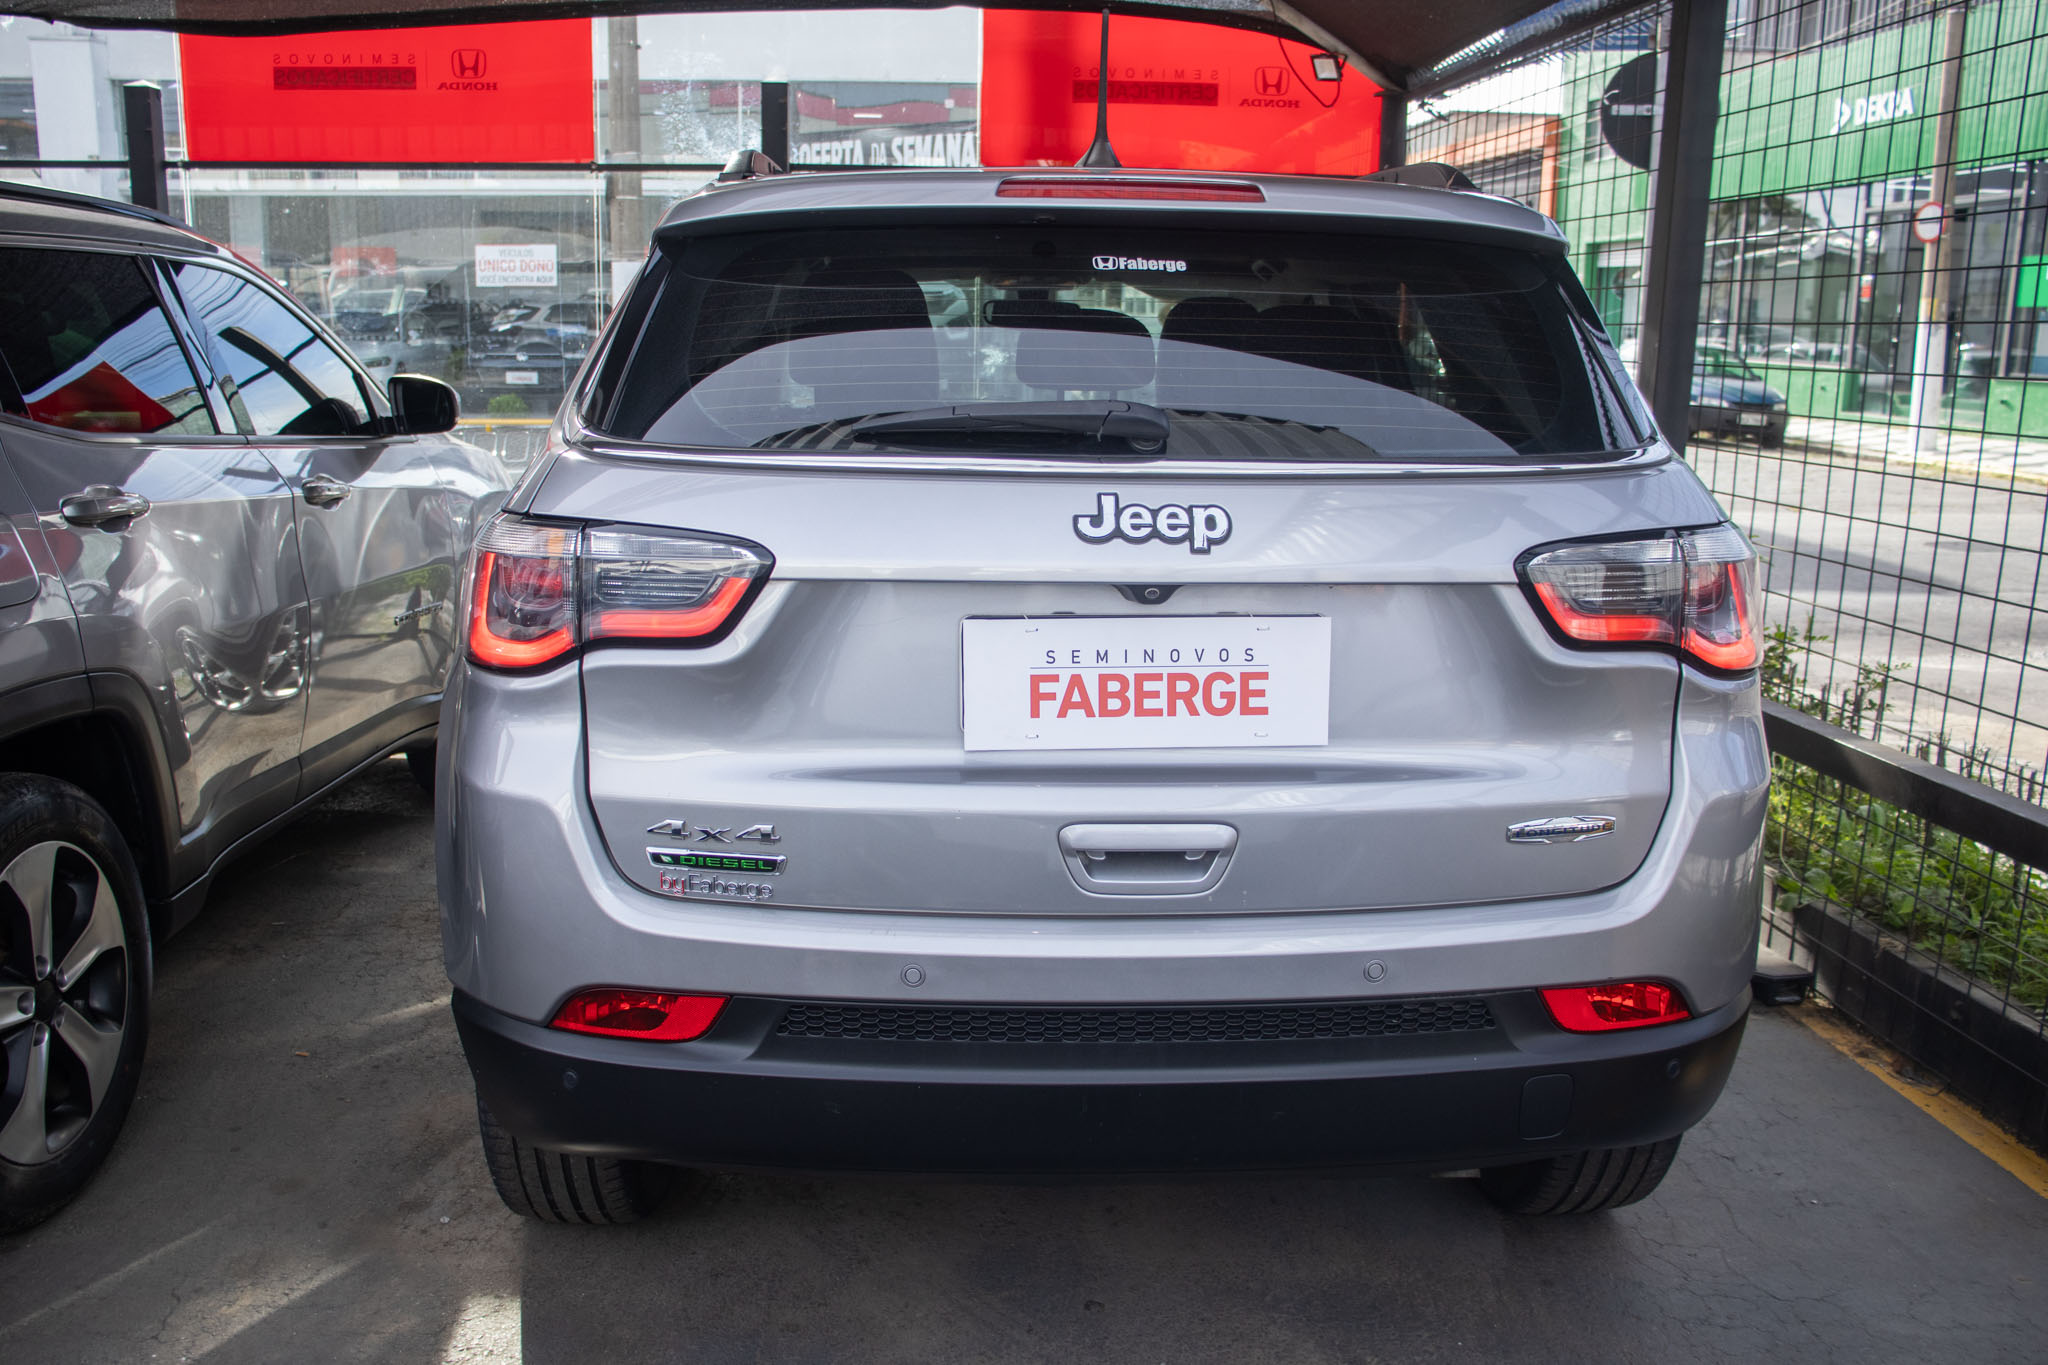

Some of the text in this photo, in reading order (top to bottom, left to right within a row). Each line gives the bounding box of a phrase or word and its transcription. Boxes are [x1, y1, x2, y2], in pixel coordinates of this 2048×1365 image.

[1854, 88, 1915, 126] DEKRA
[870, 142, 887, 166] DA
[891, 132, 976, 167] SEMANA
[520, 259, 555, 273] DONO
[1118, 256, 1187, 273] Faberge
[1072, 492, 1233, 555] Jeep
[1045, 648, 1255, 665] SEMINOVOS
[1029, 671, 1270, 719] FABERGE
[646, 818, 782, 845] 4x4
[679, 854, 774, 871] DIESEL
